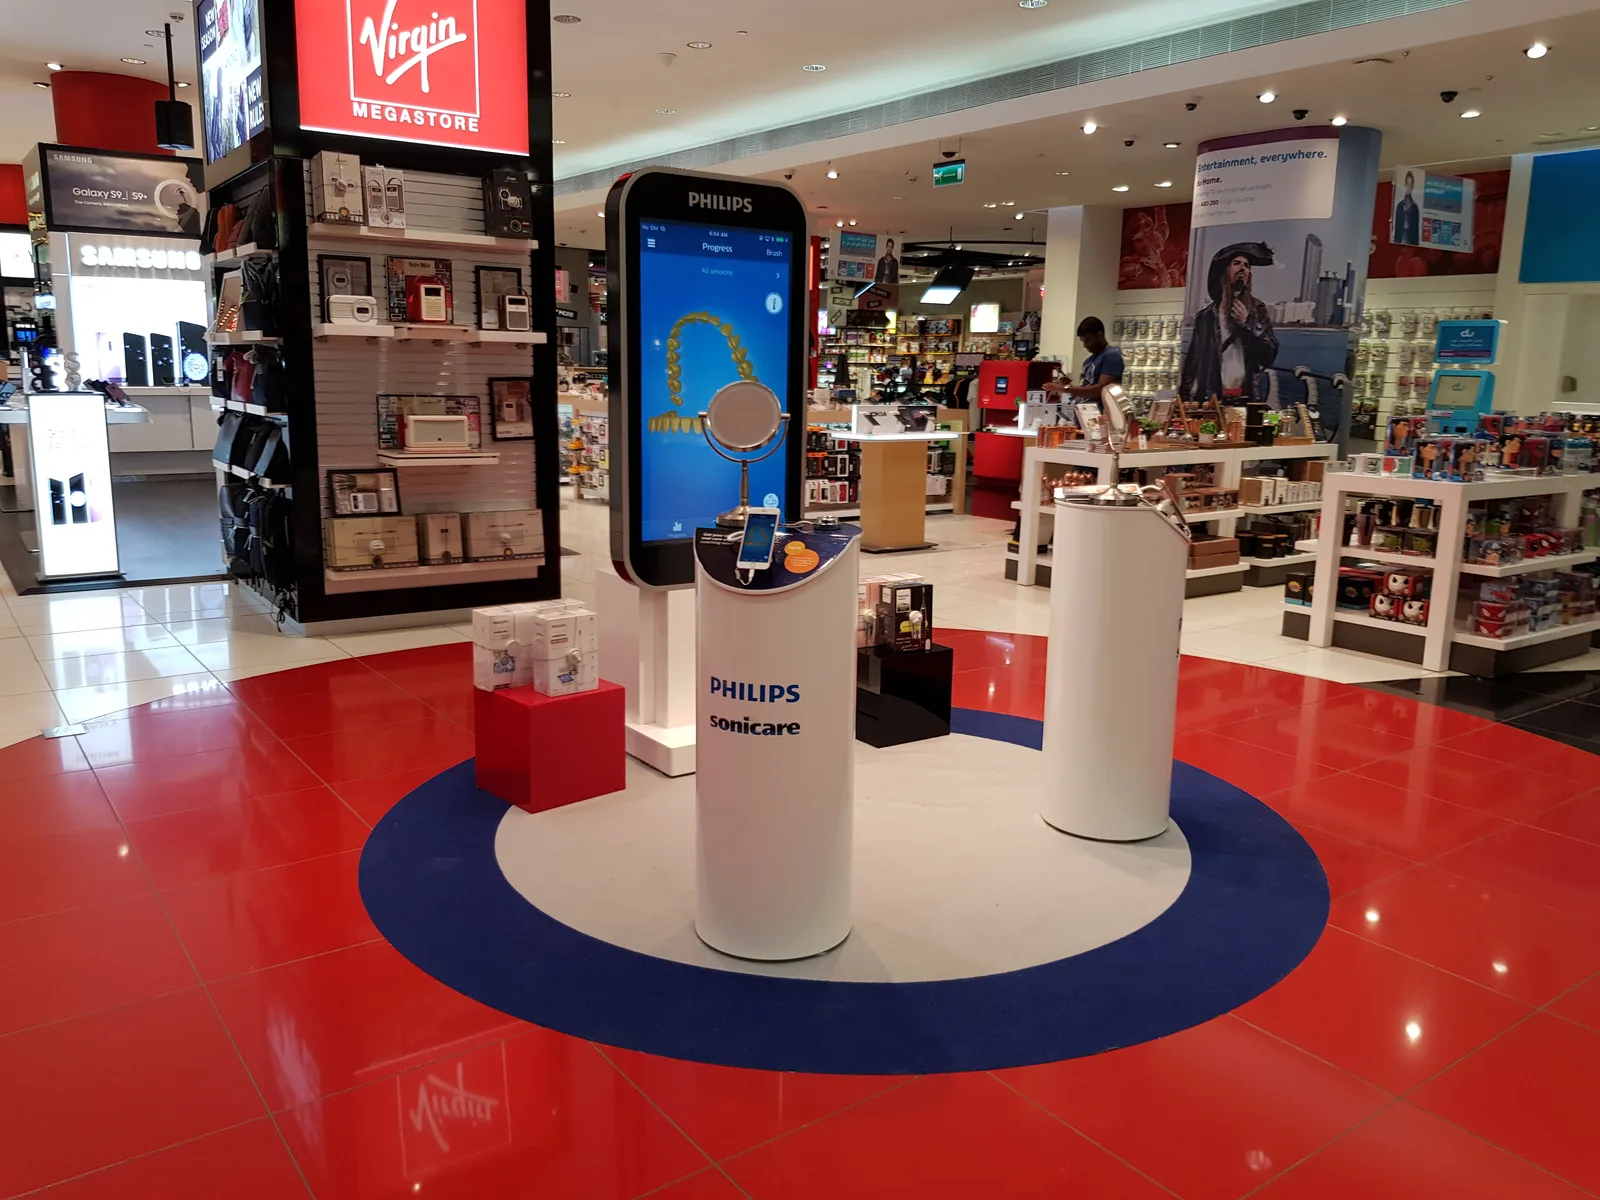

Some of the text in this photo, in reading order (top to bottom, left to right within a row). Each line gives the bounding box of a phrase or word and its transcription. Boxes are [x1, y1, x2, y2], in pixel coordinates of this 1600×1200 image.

[360, 0, 467, 93] Virgin
[248, 76, 262, 105] NEW
[353, 102, 479, 133] MEGASTORE
[53, 153, 93, 164] SAMSUNG
[1198, 150, 1328, 173] Entertainment, everywhere.
[1202, 177, 1223, 186] Home.
[72, 187, 109, 200] Galaxy
[132, 192, 148, 201] S9+
[688, 192, 753, 213] PHILIPS
[702, 242, 733, 253] Progress
[766, 249, 783, 257] Brush
[710, 676, 800, 703] PHILIPS
[710, 715, 801, 736] sonicare
